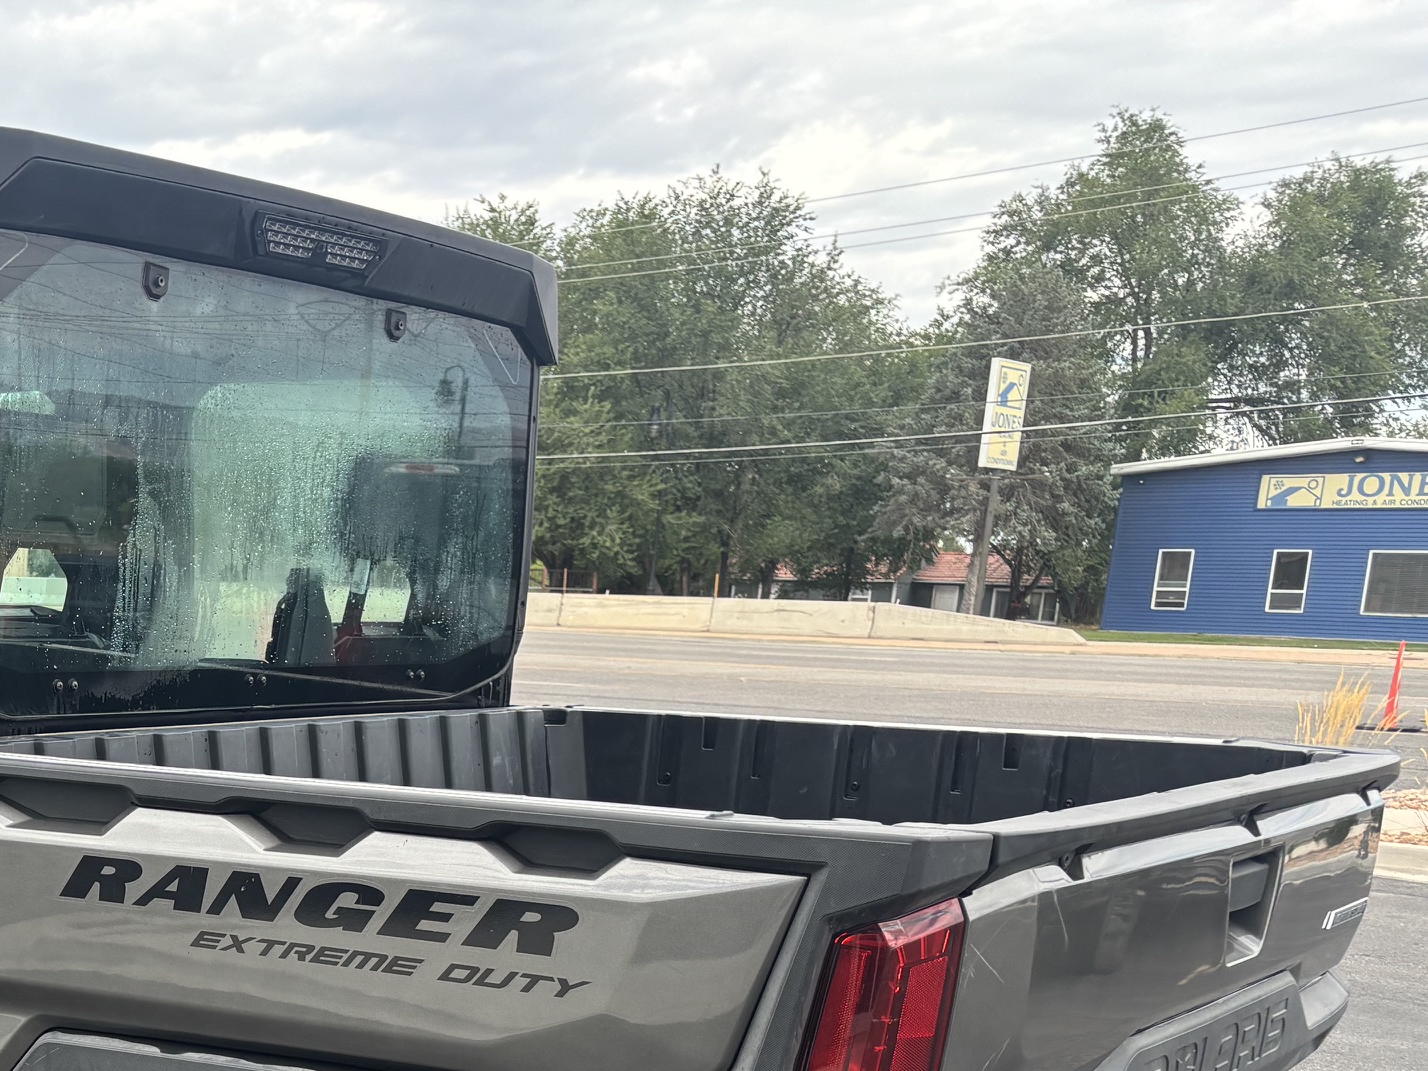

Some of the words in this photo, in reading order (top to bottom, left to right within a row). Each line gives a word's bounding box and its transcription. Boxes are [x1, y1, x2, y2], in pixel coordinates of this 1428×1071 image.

[992, 412, 1022, 430] JONES
[60, 855, 580, 957] RANGER
[189, 931, 425, 977] EXTREME
[436, 963, 592, 999] DUTY
